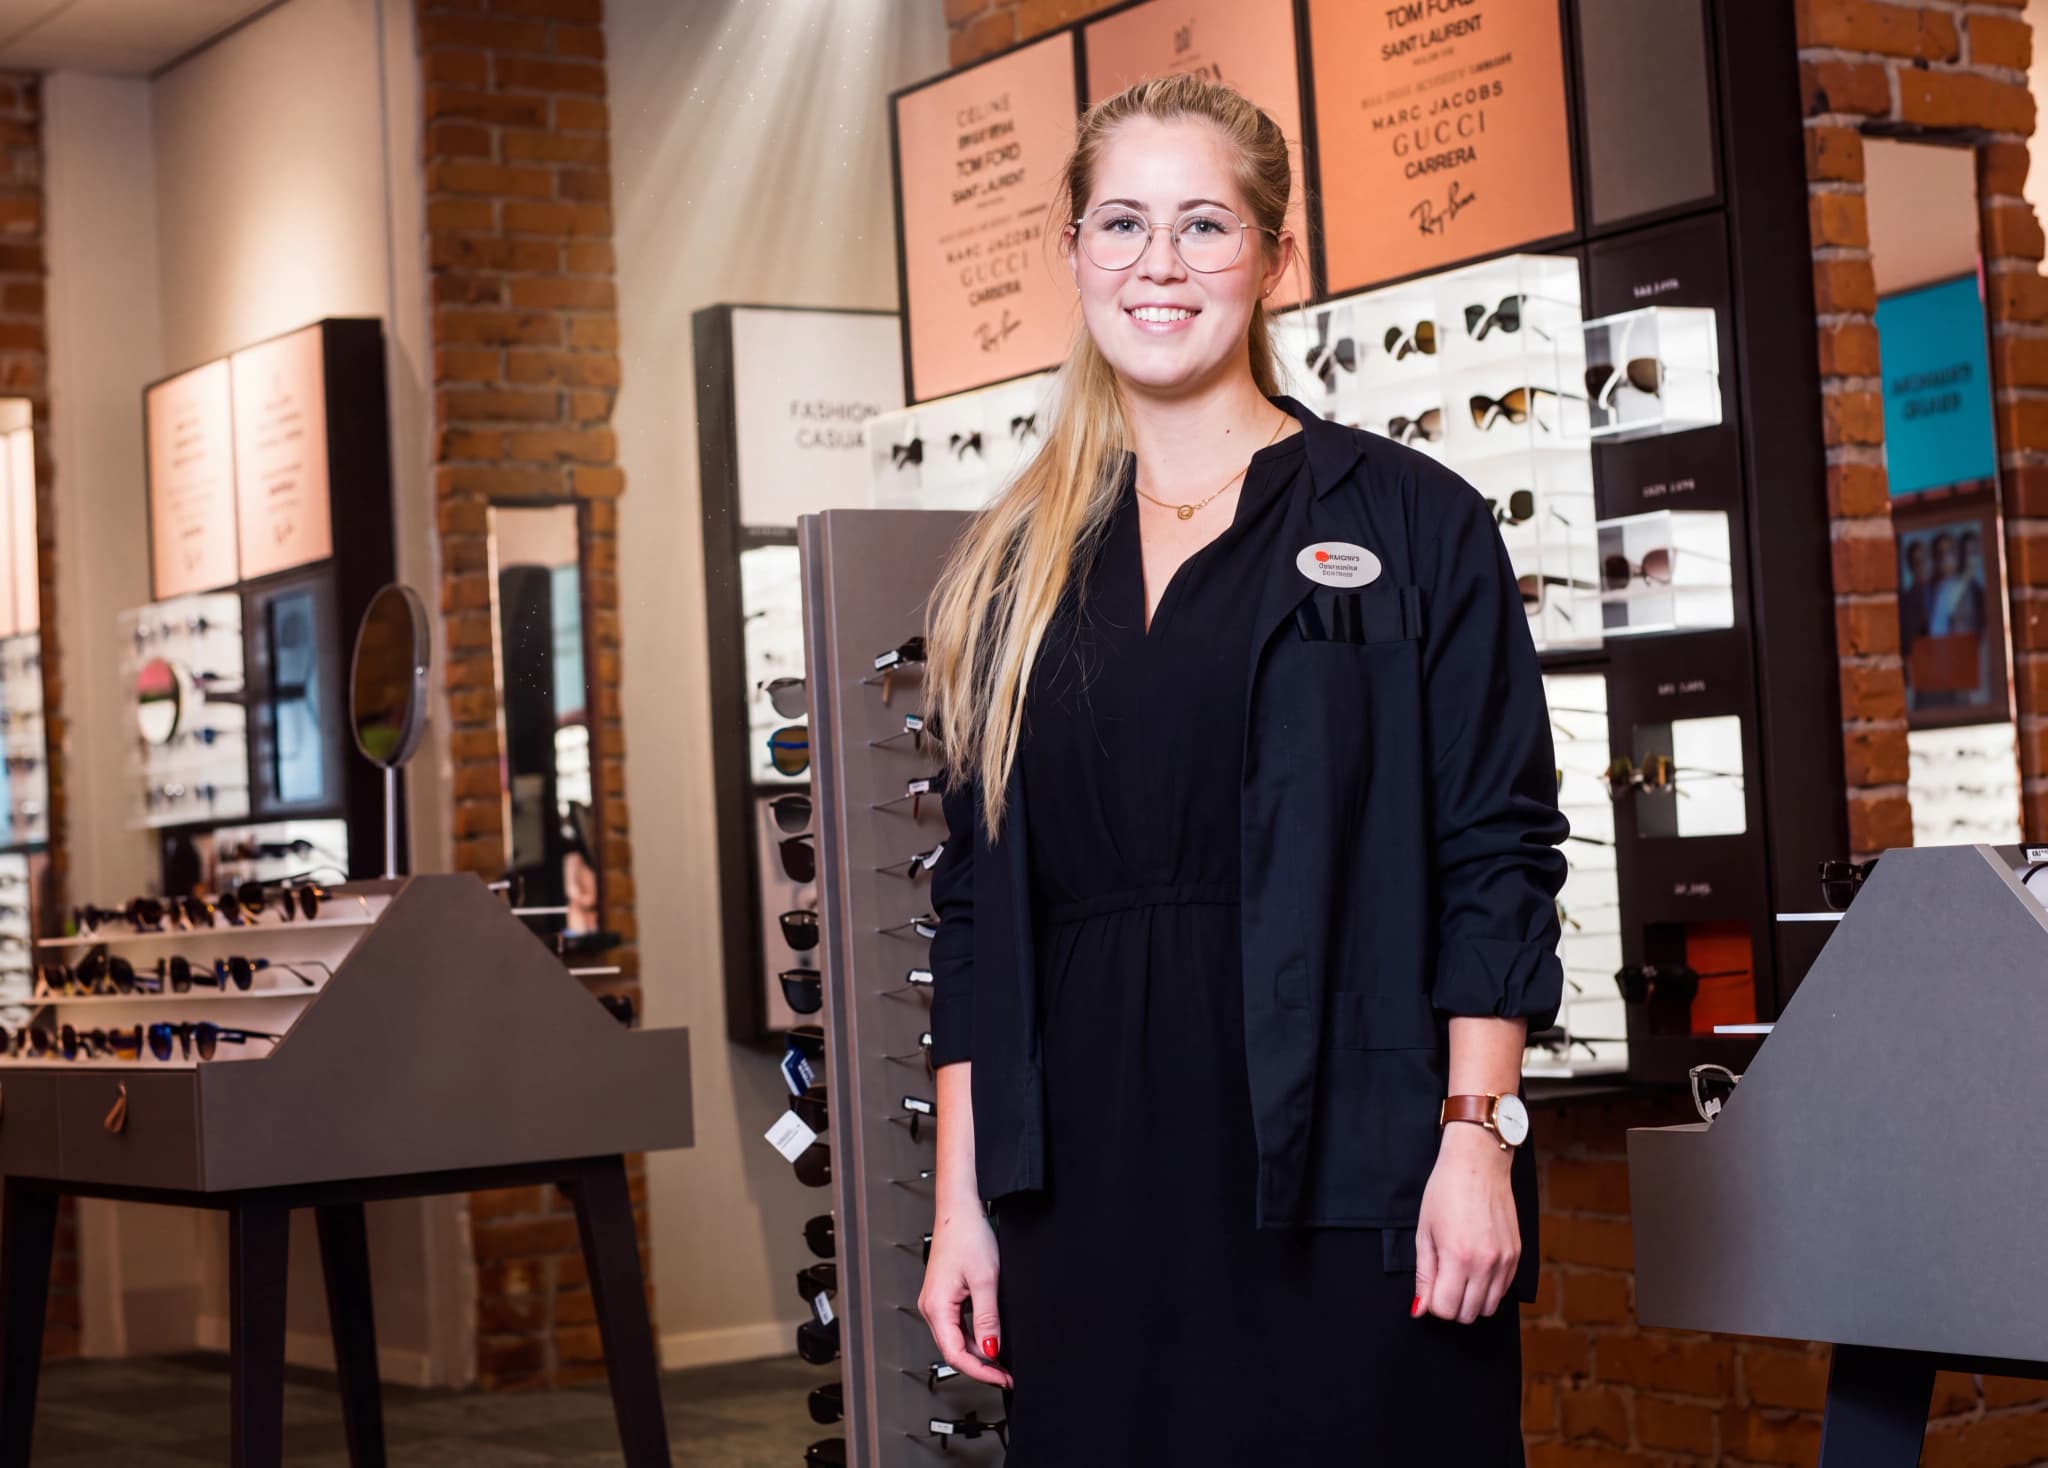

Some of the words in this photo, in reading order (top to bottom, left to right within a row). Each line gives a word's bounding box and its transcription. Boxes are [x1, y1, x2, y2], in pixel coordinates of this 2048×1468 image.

[1385, 2, 1423, 30] TOM
[1381, 35, 1417, 61] SAINT
[1420, 14, 1483, 48] LAURENT
[1372, 105, 1422, 131] MARC
[1429, 80, 1504, 116] JACOBS
[1392, 109, 1486, 158] GUCCI
[1404, 145, 1477, 179] CARRERA
[794, 427, 864, 450] CASUA
